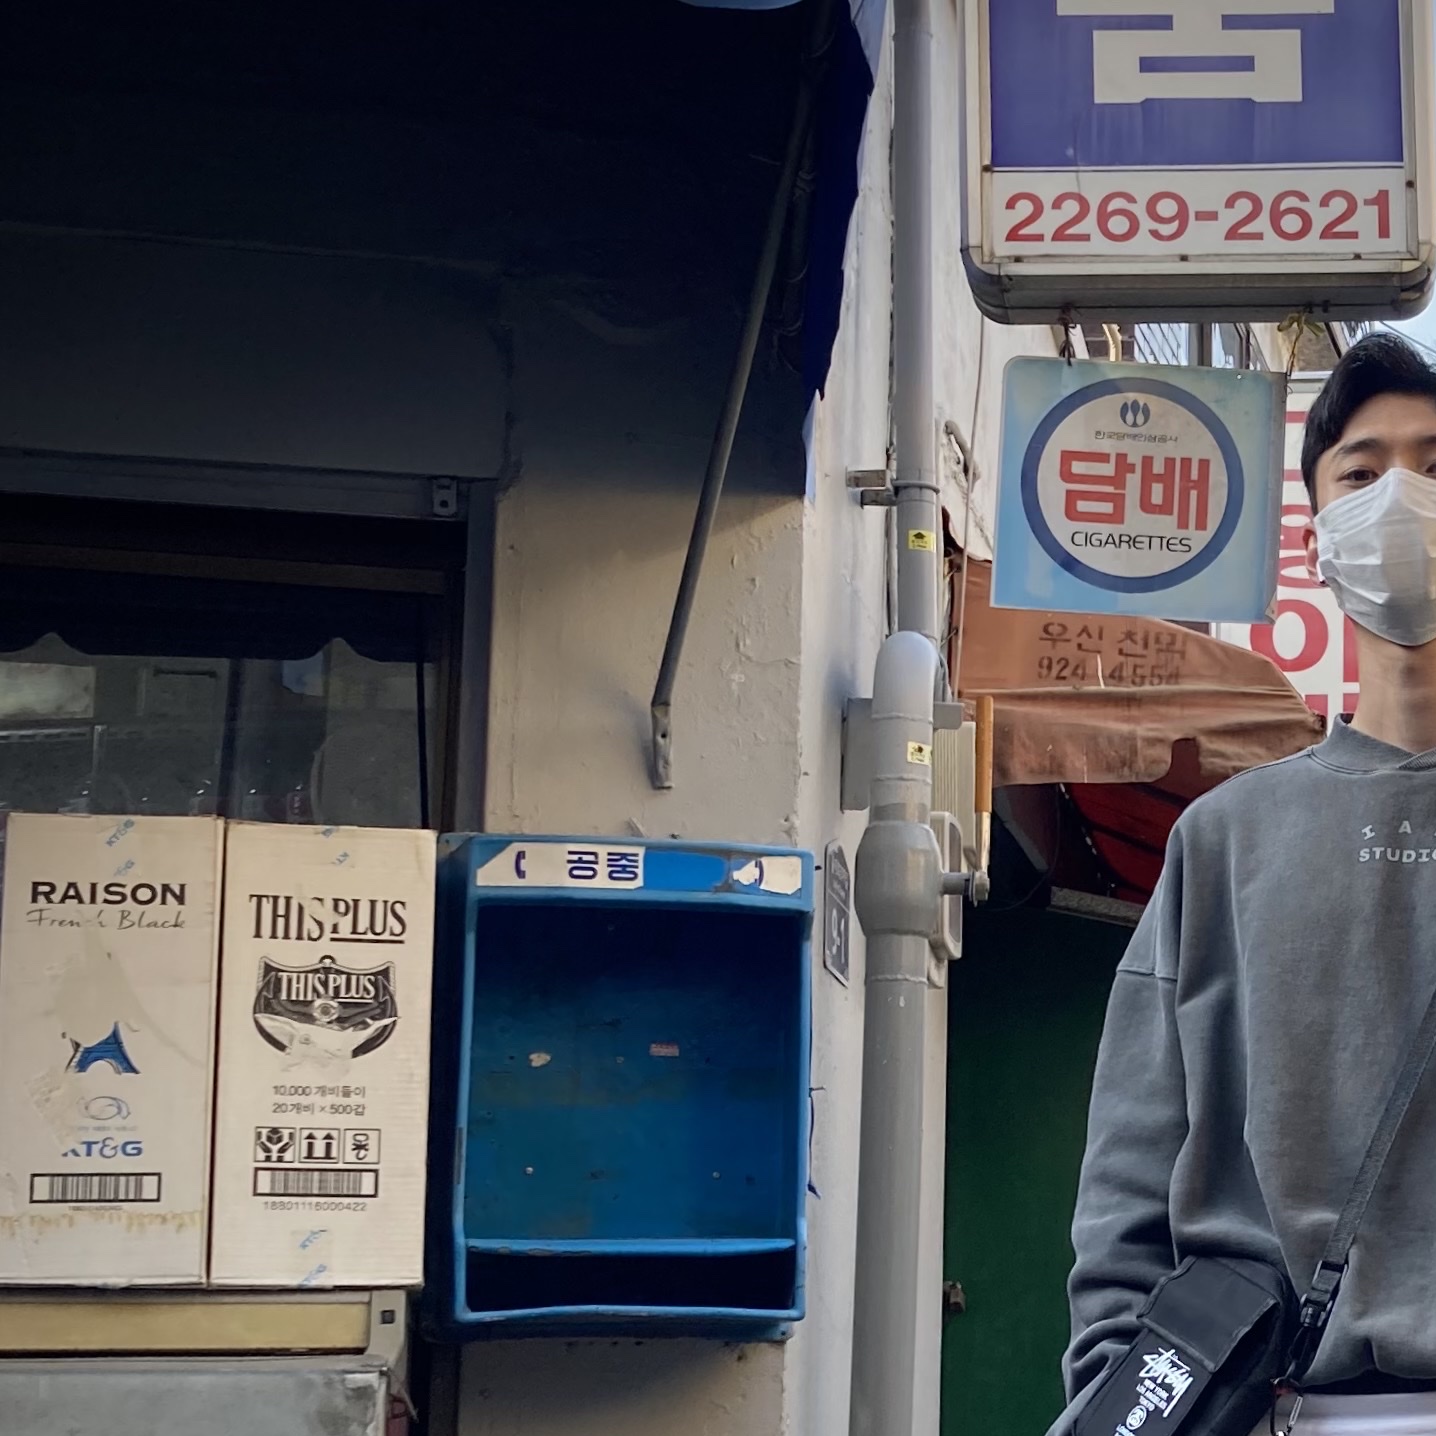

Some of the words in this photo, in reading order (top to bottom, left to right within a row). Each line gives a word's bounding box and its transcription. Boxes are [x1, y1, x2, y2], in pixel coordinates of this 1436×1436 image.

[1005, 189, 1391, 242] 2269-2621
[1059, 449, 1211, 531] 담배
[1071, 531, 1193, 553] CIGARETTES
[566, 850, 640, 882] 공중
[30, 881, 187, 906] RAISON
[117, 910, 186, 930] Black
[249, 894, 324, 941] THIS
[329, 898, 407, 938] PLUS
[278, 972, 325, 1000] THIS
[327, 973, 376, 999] PLUS
